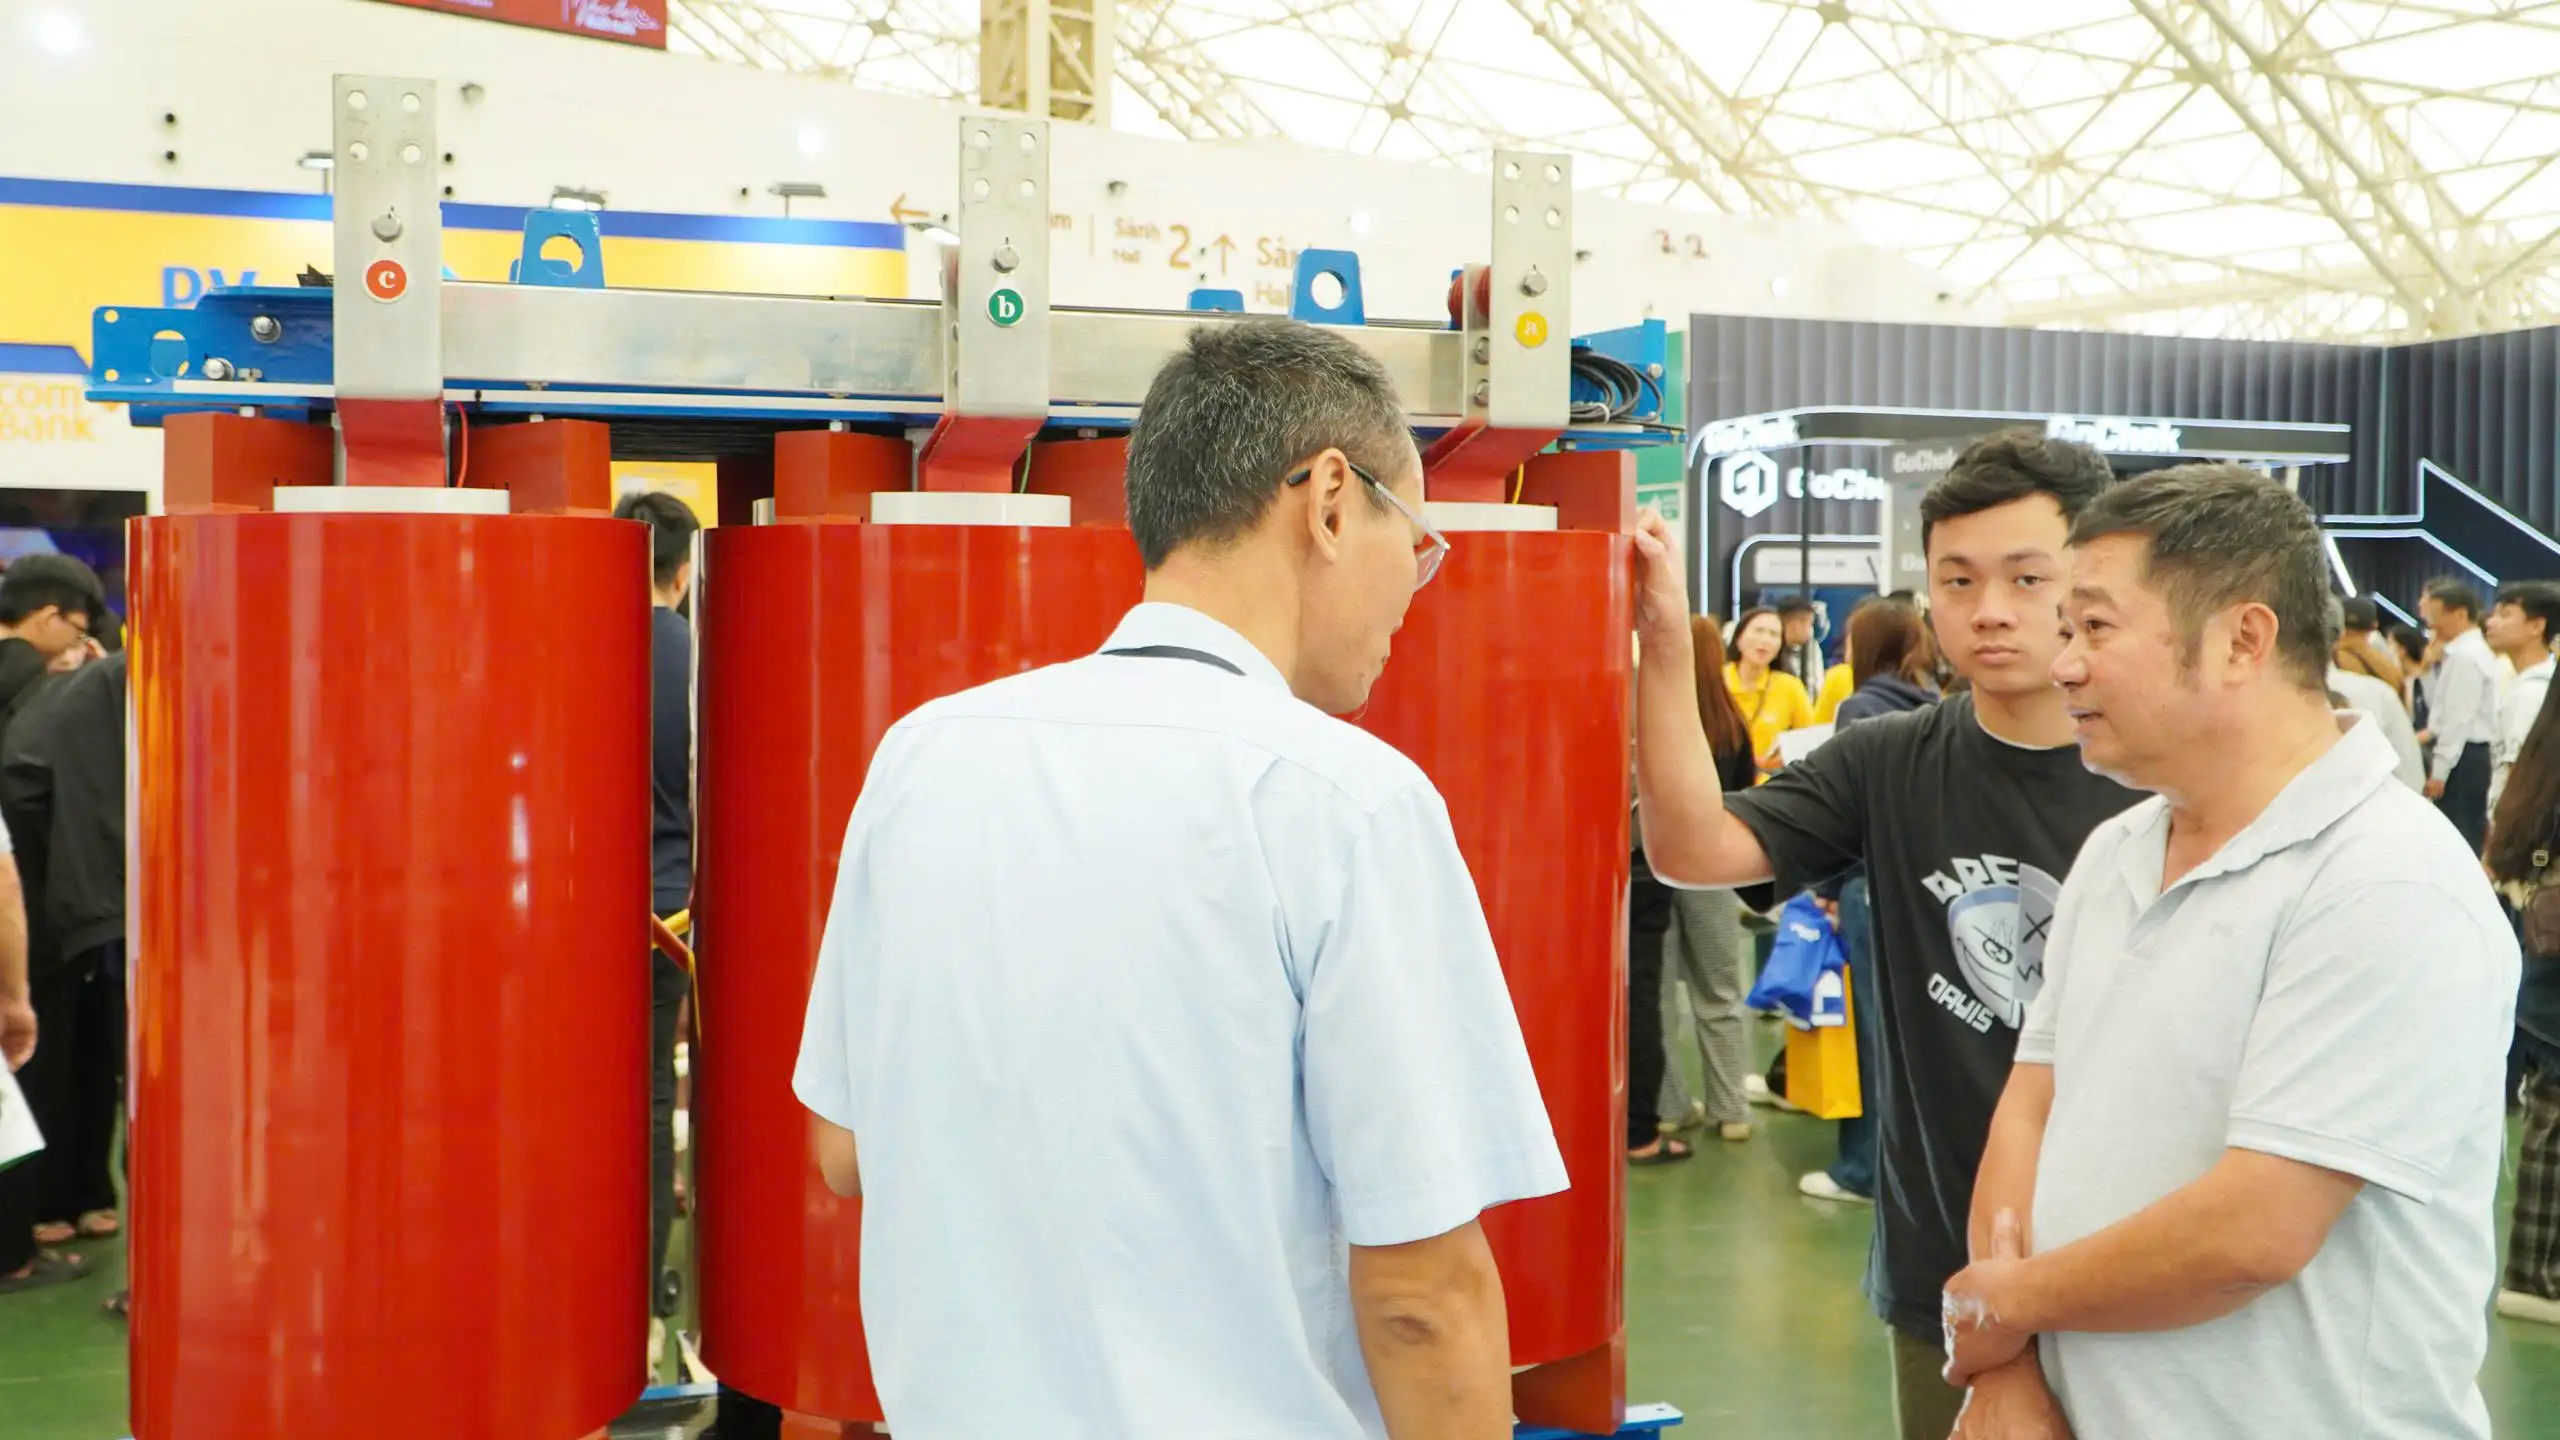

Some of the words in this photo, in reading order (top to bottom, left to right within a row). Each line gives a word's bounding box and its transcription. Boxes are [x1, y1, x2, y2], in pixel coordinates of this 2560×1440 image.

[1169, 224, 1191, 268] 2
[378, 270, 396, 289] c
[1255, 281, 1291, 307] Hal
[997, 295, 1016, 318] b
